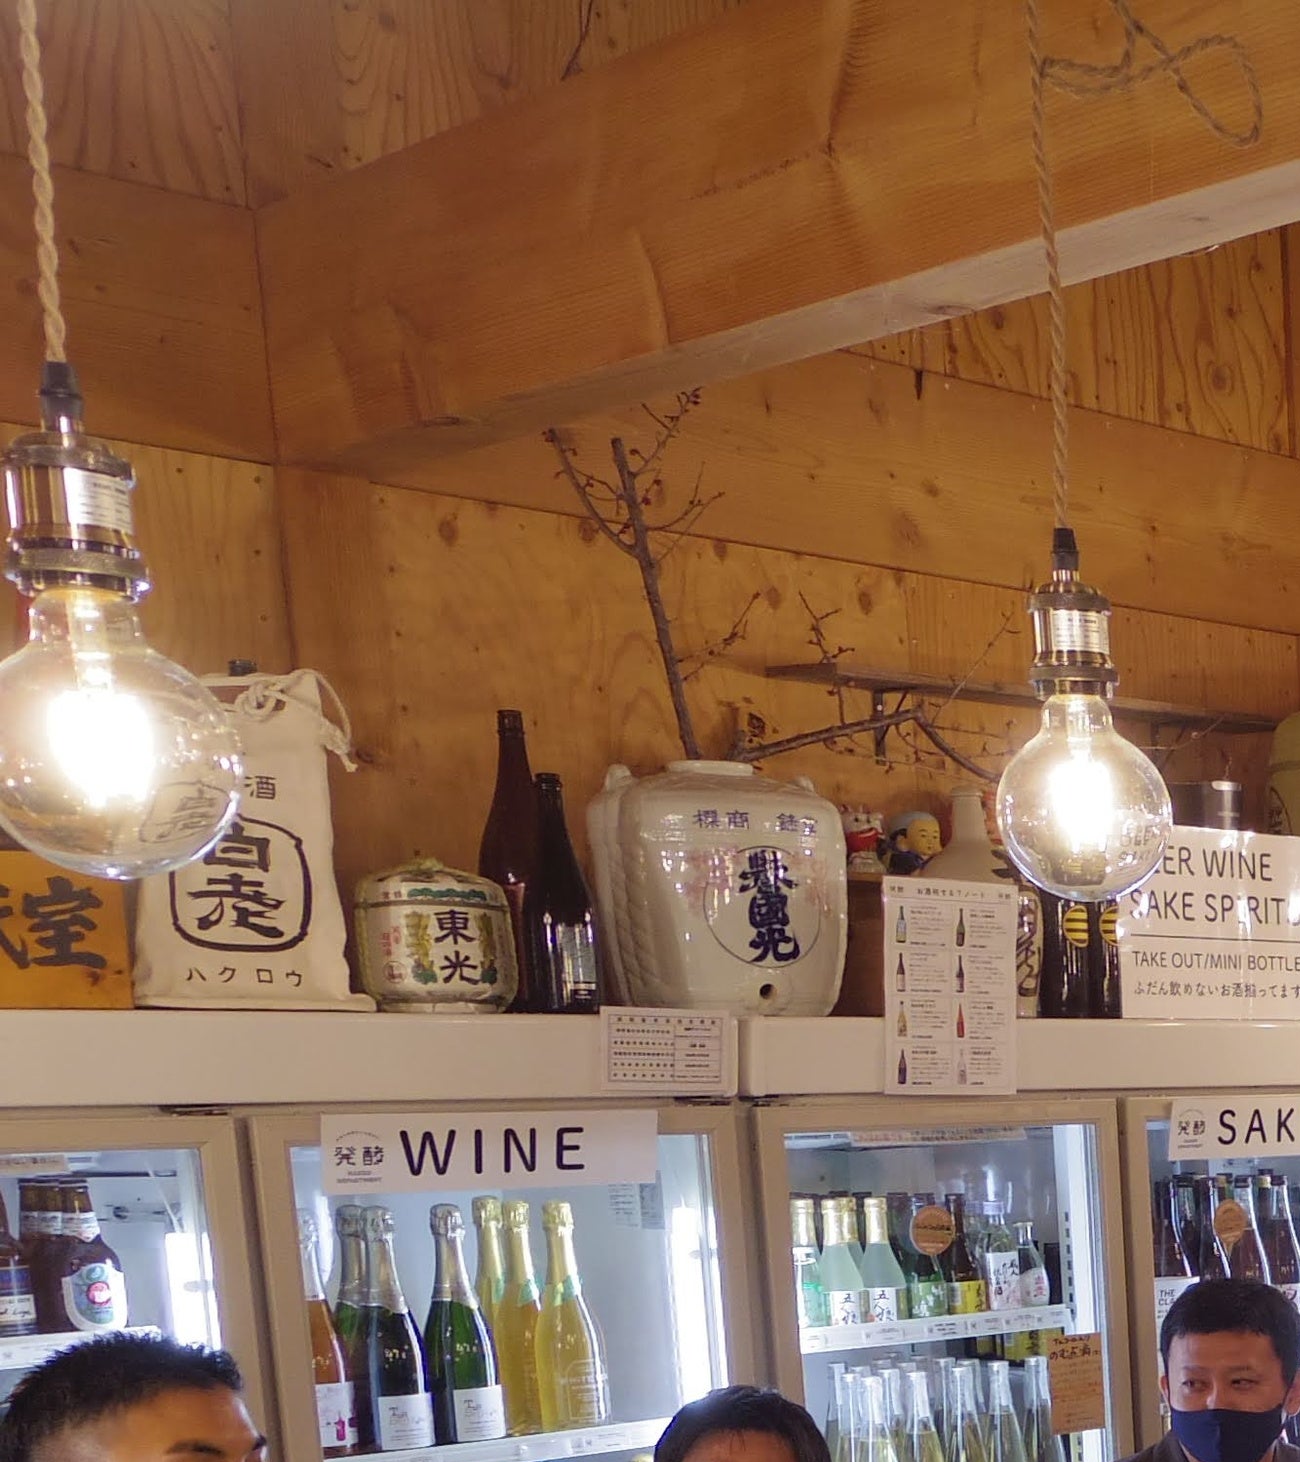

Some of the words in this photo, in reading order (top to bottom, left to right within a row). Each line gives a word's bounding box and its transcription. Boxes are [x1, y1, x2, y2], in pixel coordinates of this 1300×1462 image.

[1202, 848, 1273, 882] WINE
[1130, 888, 1196, 922] SAKE
[433, 909, 483, 986] 東光
[1132, 950, 1167, 968] TAKE
[1171, 952, 1242, 971] OUT/MINI
[186, 966, 303, 988] ハクロウ
[399, 1126, 585, 1177] WINE
